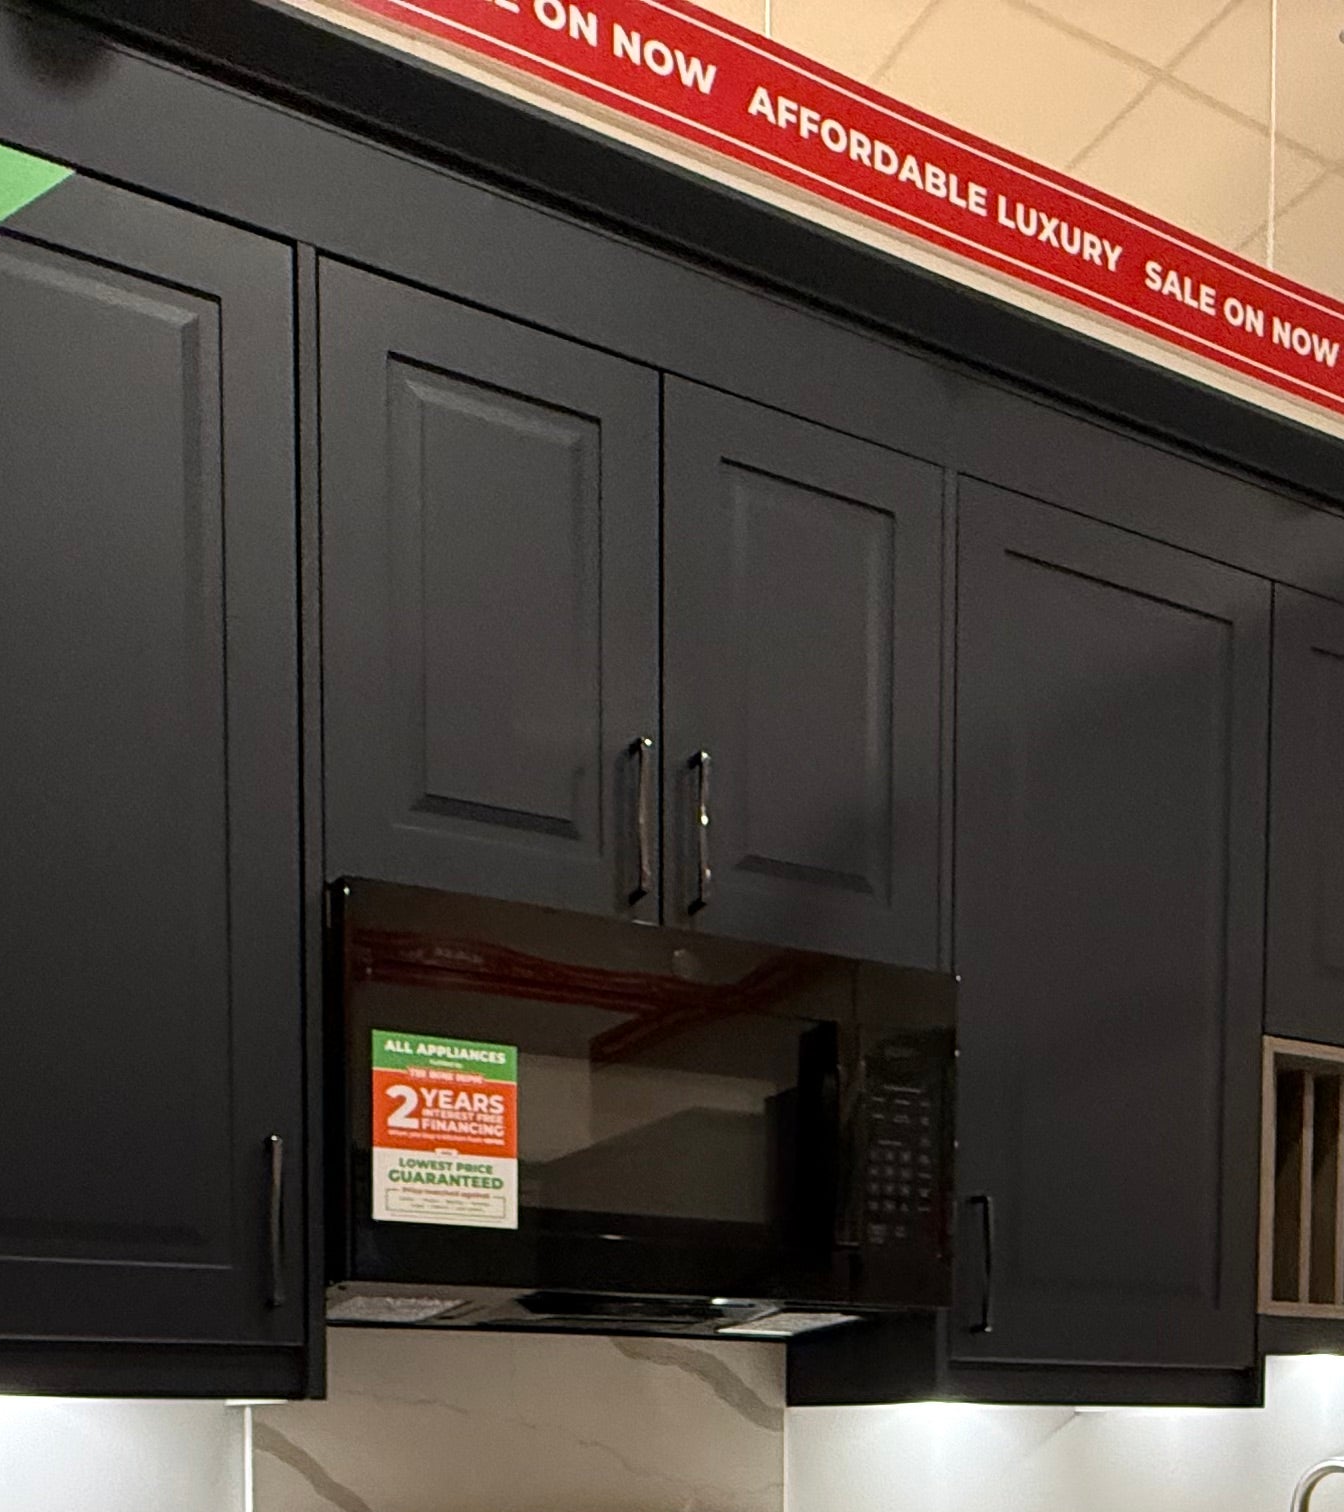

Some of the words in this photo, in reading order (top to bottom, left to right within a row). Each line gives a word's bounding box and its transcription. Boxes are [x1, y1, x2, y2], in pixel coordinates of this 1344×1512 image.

[533, 0, 598, 47] ON
[613, 23, 717, 94] NOW
[747, 86, 988, 217] AFFORDABLE
[997, 194, 1123, 272] LUXURY
[1144, 261, 1216, 316] SALE
[1223, 297, 1264, 337] ON
[1271, 317, 1339, 367] NOW
[384, 1039, 413, 1054] ALL
[416, 1043, 506, 1065] APPLIANCES
[385, 1084, 420, 1129] 2
[419, 1087, 504, 1115] YEARS
[421, 1118, 505, 1137] FINANCING
[399, 1157, 453, 1171] LOWEST
[456, 1162, 493, 1174] PRICE
[388, 1169, 504, 1190] GUARANTEED
